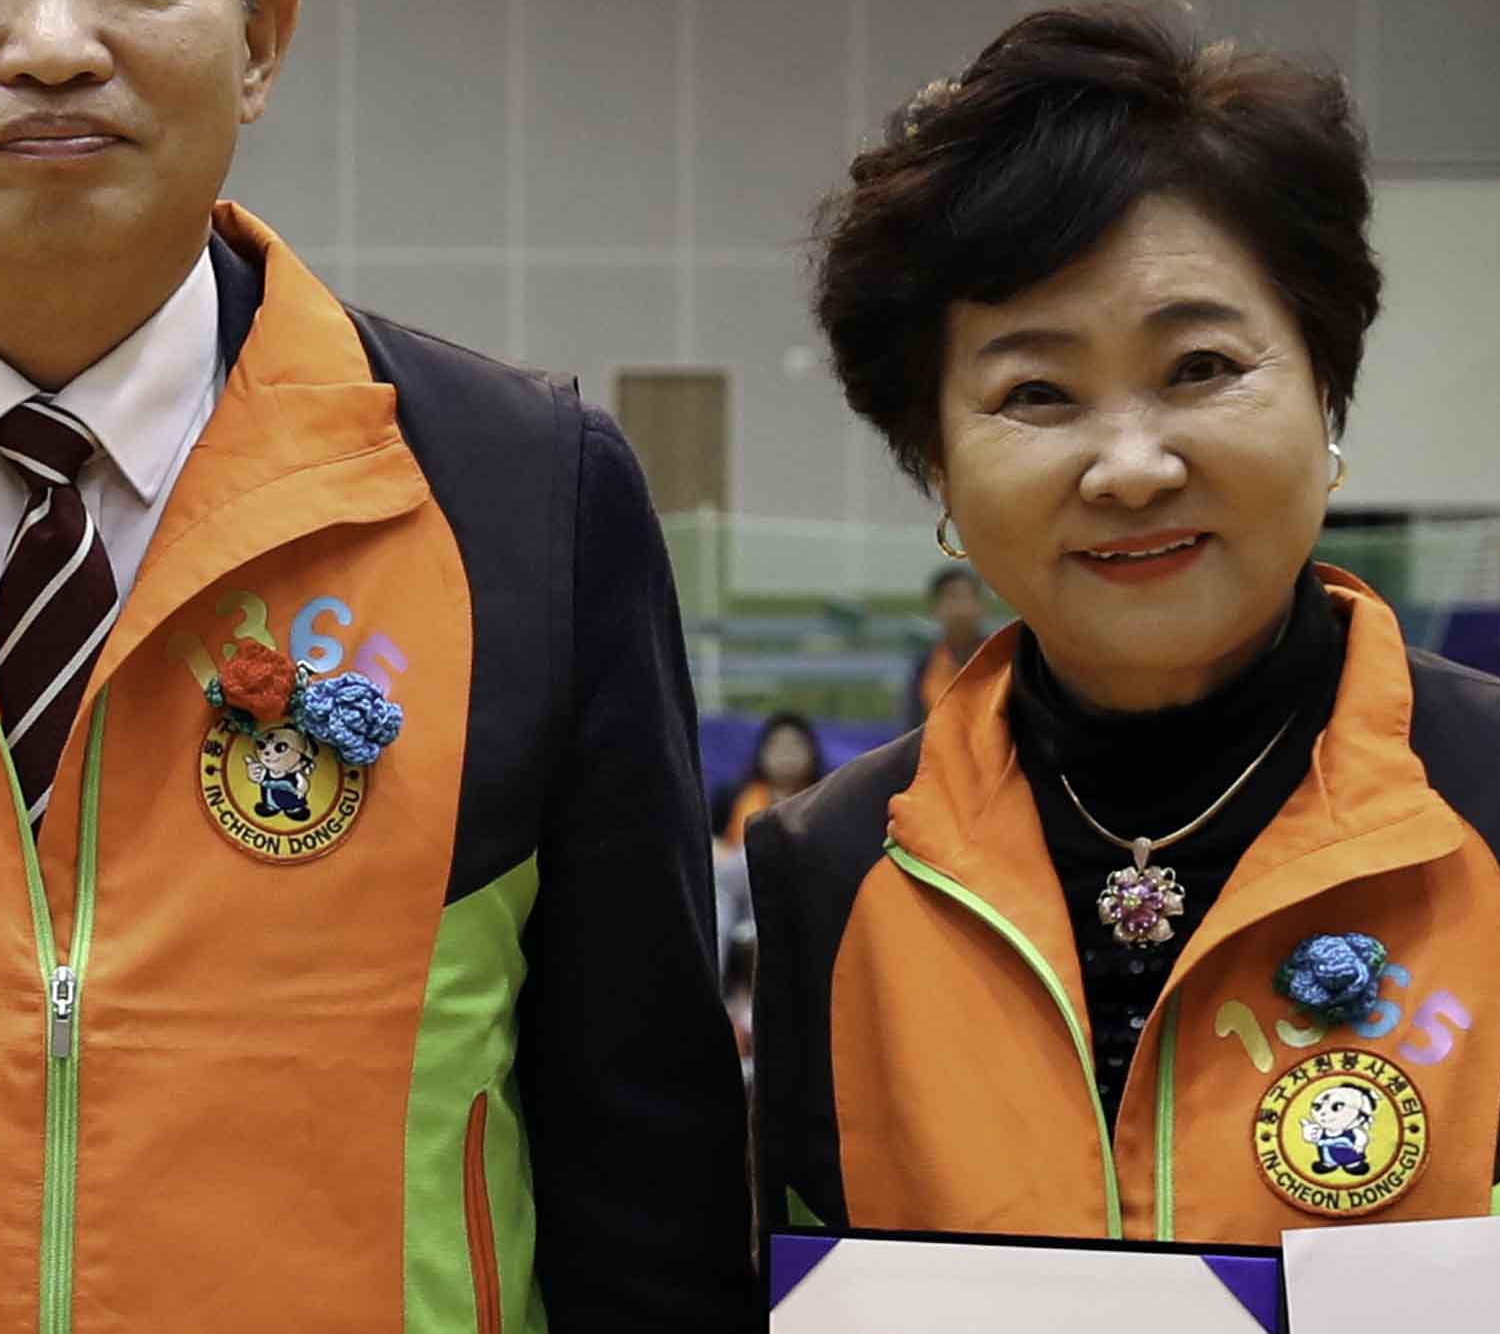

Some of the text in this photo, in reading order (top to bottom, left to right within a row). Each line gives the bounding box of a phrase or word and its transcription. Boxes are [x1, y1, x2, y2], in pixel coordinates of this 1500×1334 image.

[205, 784, 360, 855] IN-CHEON DONG-GU
[1260, 1143, 1421, 1210] IN-CHEON DONG-GU
